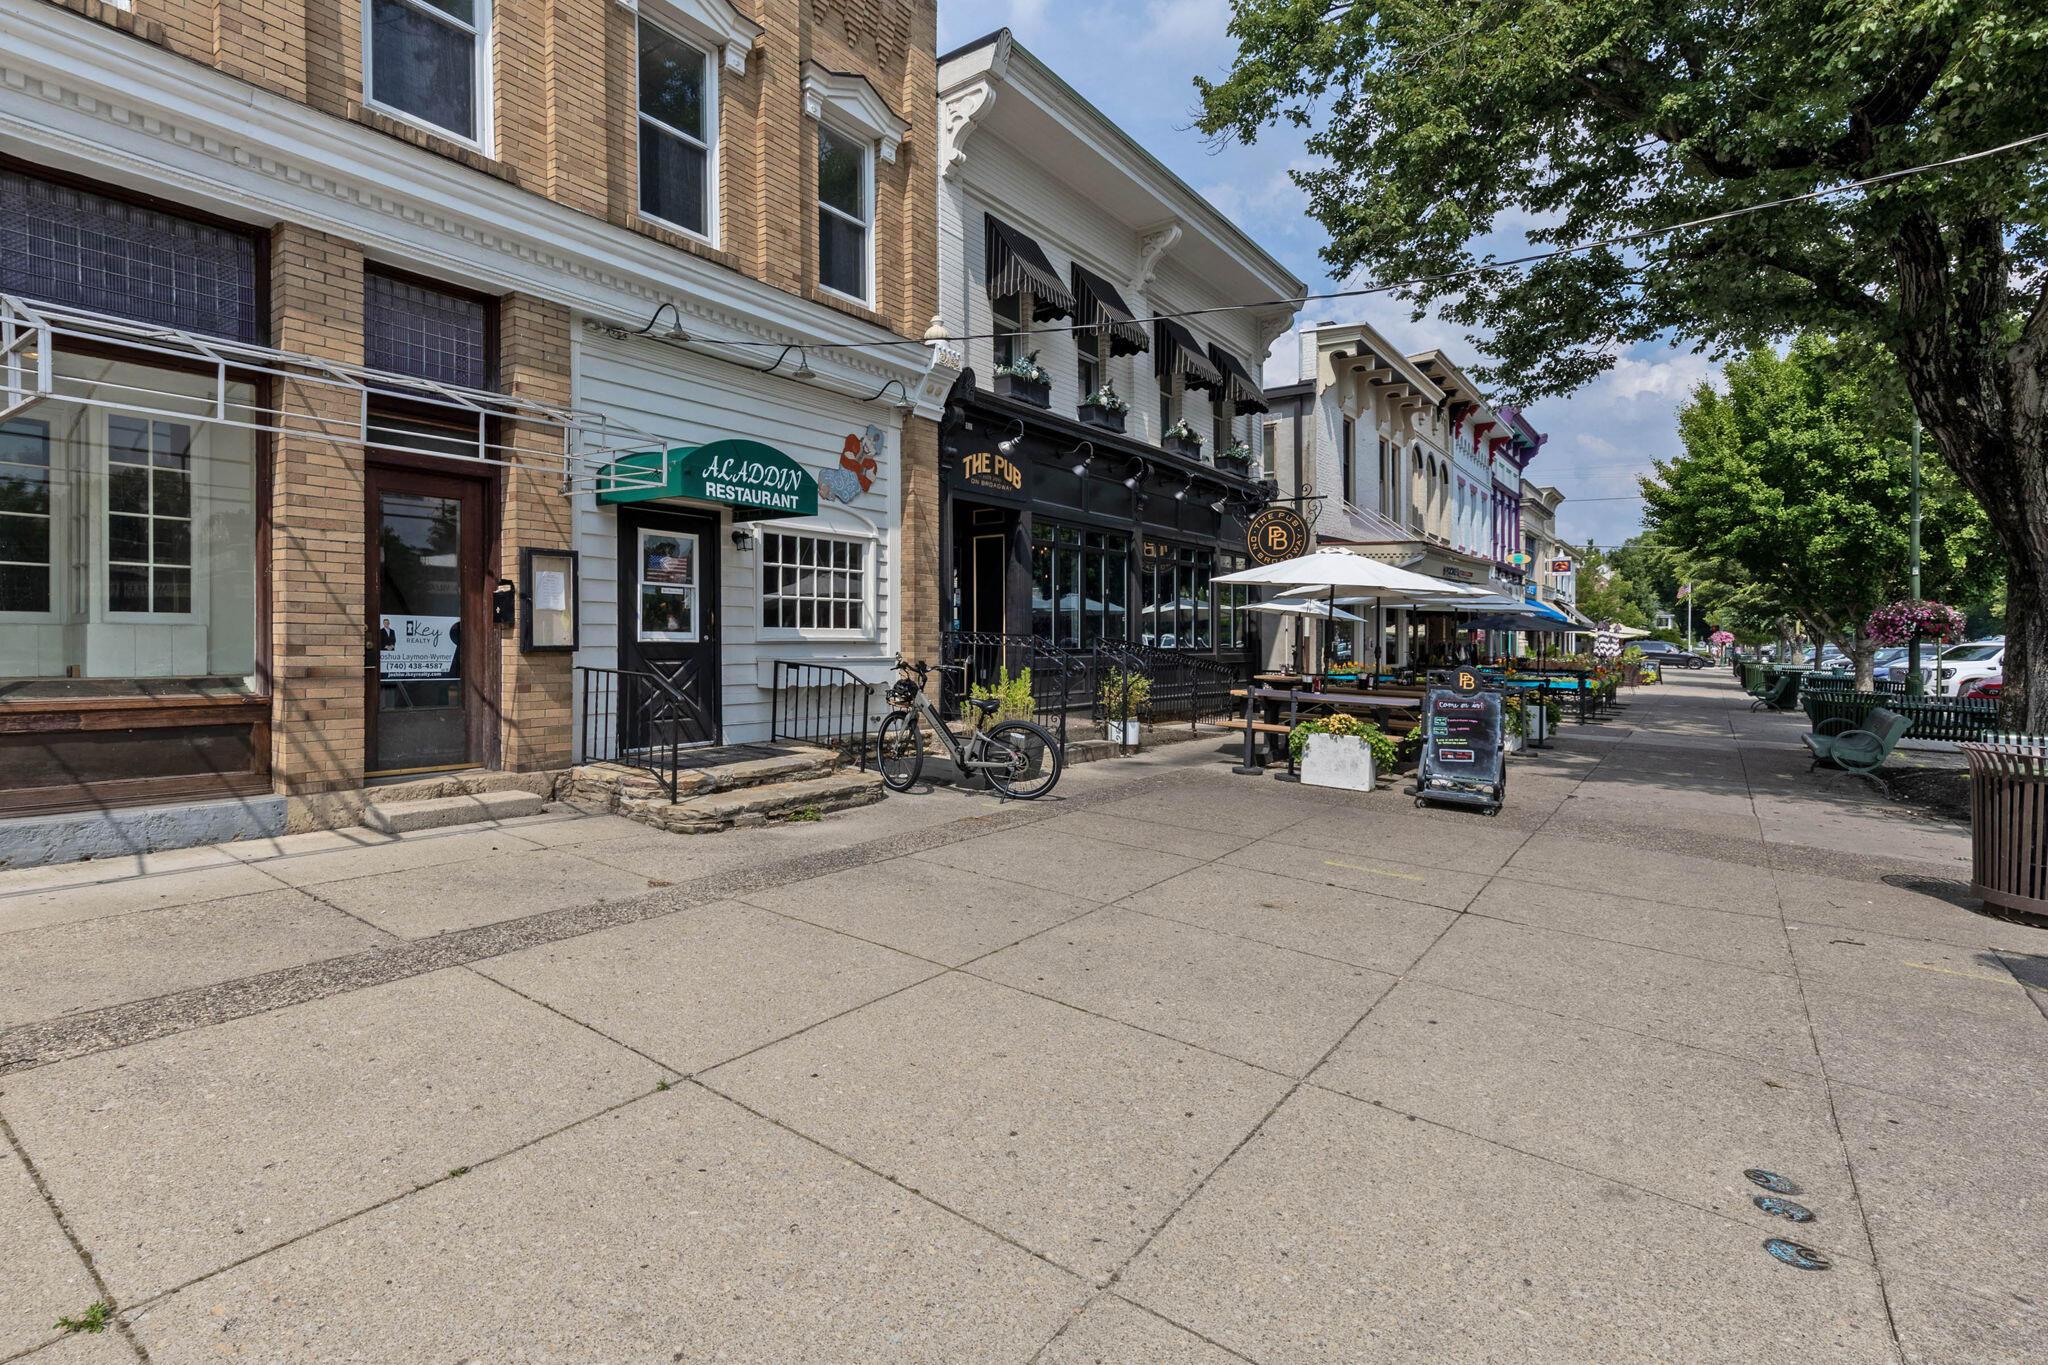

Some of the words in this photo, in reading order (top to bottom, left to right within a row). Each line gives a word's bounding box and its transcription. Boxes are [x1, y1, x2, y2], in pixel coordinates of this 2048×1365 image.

[702, 456, 801, 491] ALADDIN
[963, 453, 991, 479] THE
[995, 455, 1021, 489] PUB
[981, 480, 1013, 491] BROADWAY
[706, 482, 799, 508] RESTAURANT
[1254, 513, 1273, 529] THE
[1278, 512, 1299, 527] PUB
[1250, 536, 1258, 550] ON
[1268, 526, 1287, 550] PB
[386, 662, 407, 671] (740)
[408, 662, 443, 670] 438-4587
[1459, 673, 1474, 690] PB
